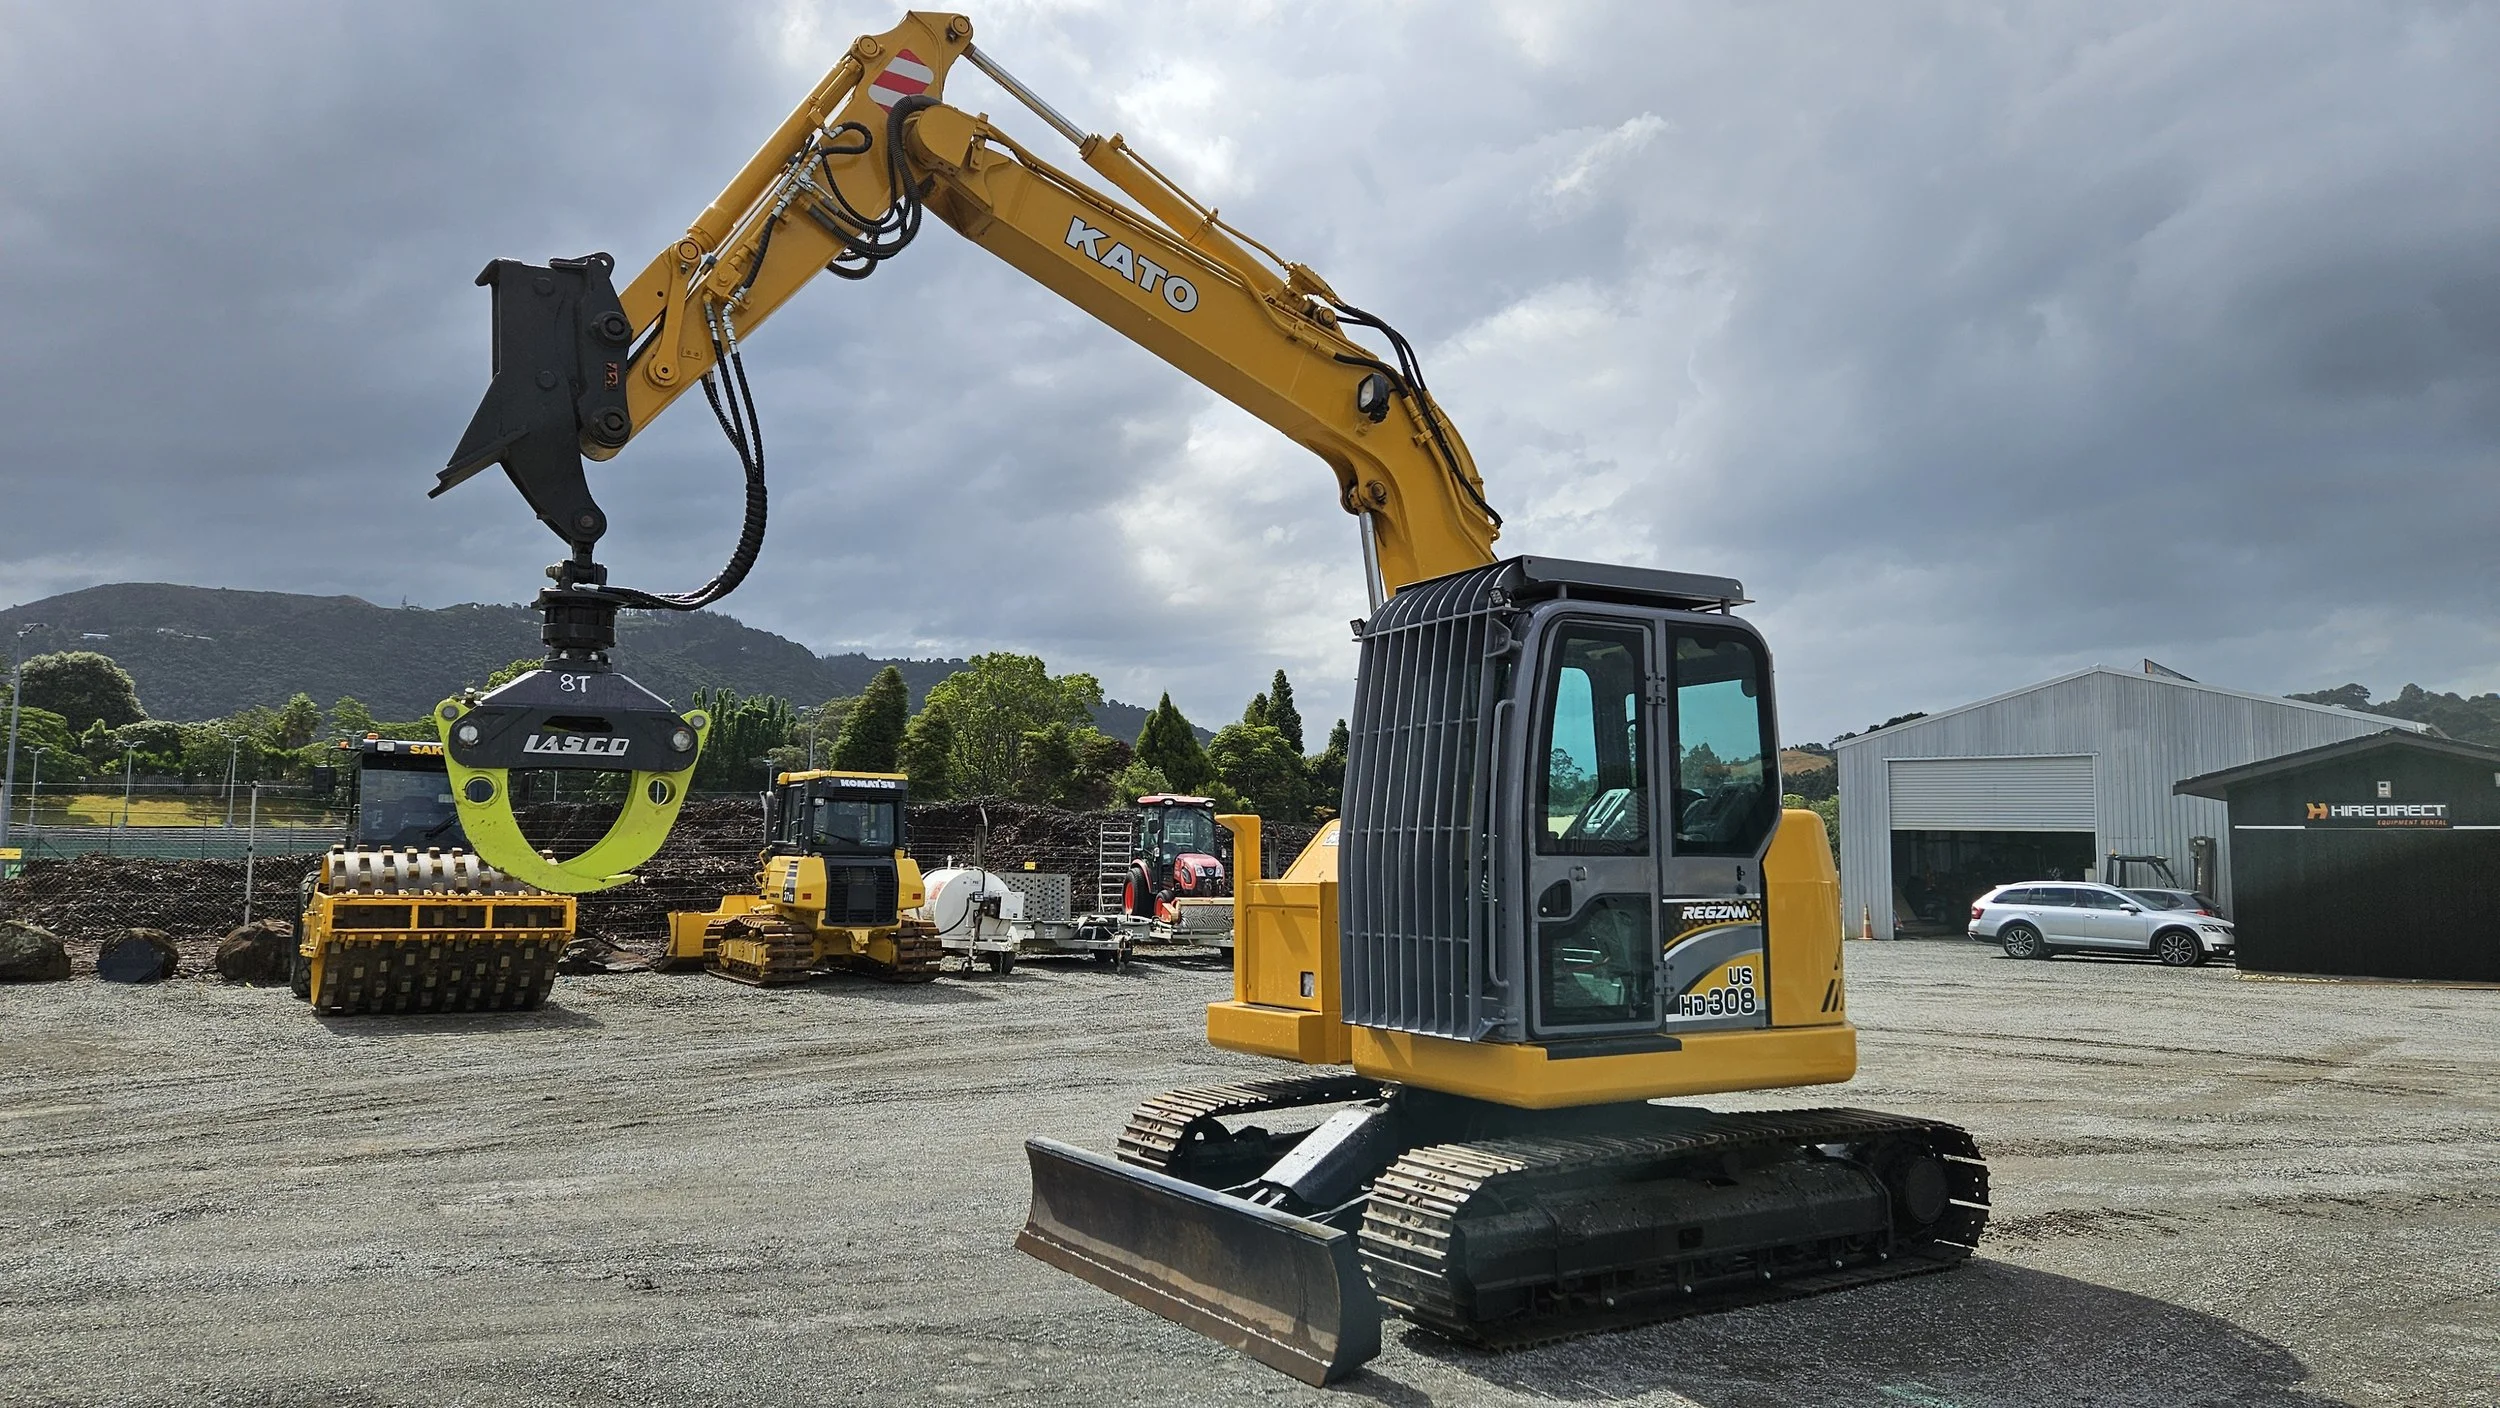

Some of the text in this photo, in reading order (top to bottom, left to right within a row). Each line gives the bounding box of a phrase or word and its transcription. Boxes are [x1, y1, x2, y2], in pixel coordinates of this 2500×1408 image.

[1064, 215, 1199, 313] KATO
[560, 673, 591, 693] 8T
[409, 744, 444, 756] SAK
[523, 734, 630, 756] LASCO
[840, 779, 896, 789] KOMATSU
[1727, 966, 1753, 986] US
[1679, 986, 1757, 1016] HD308
